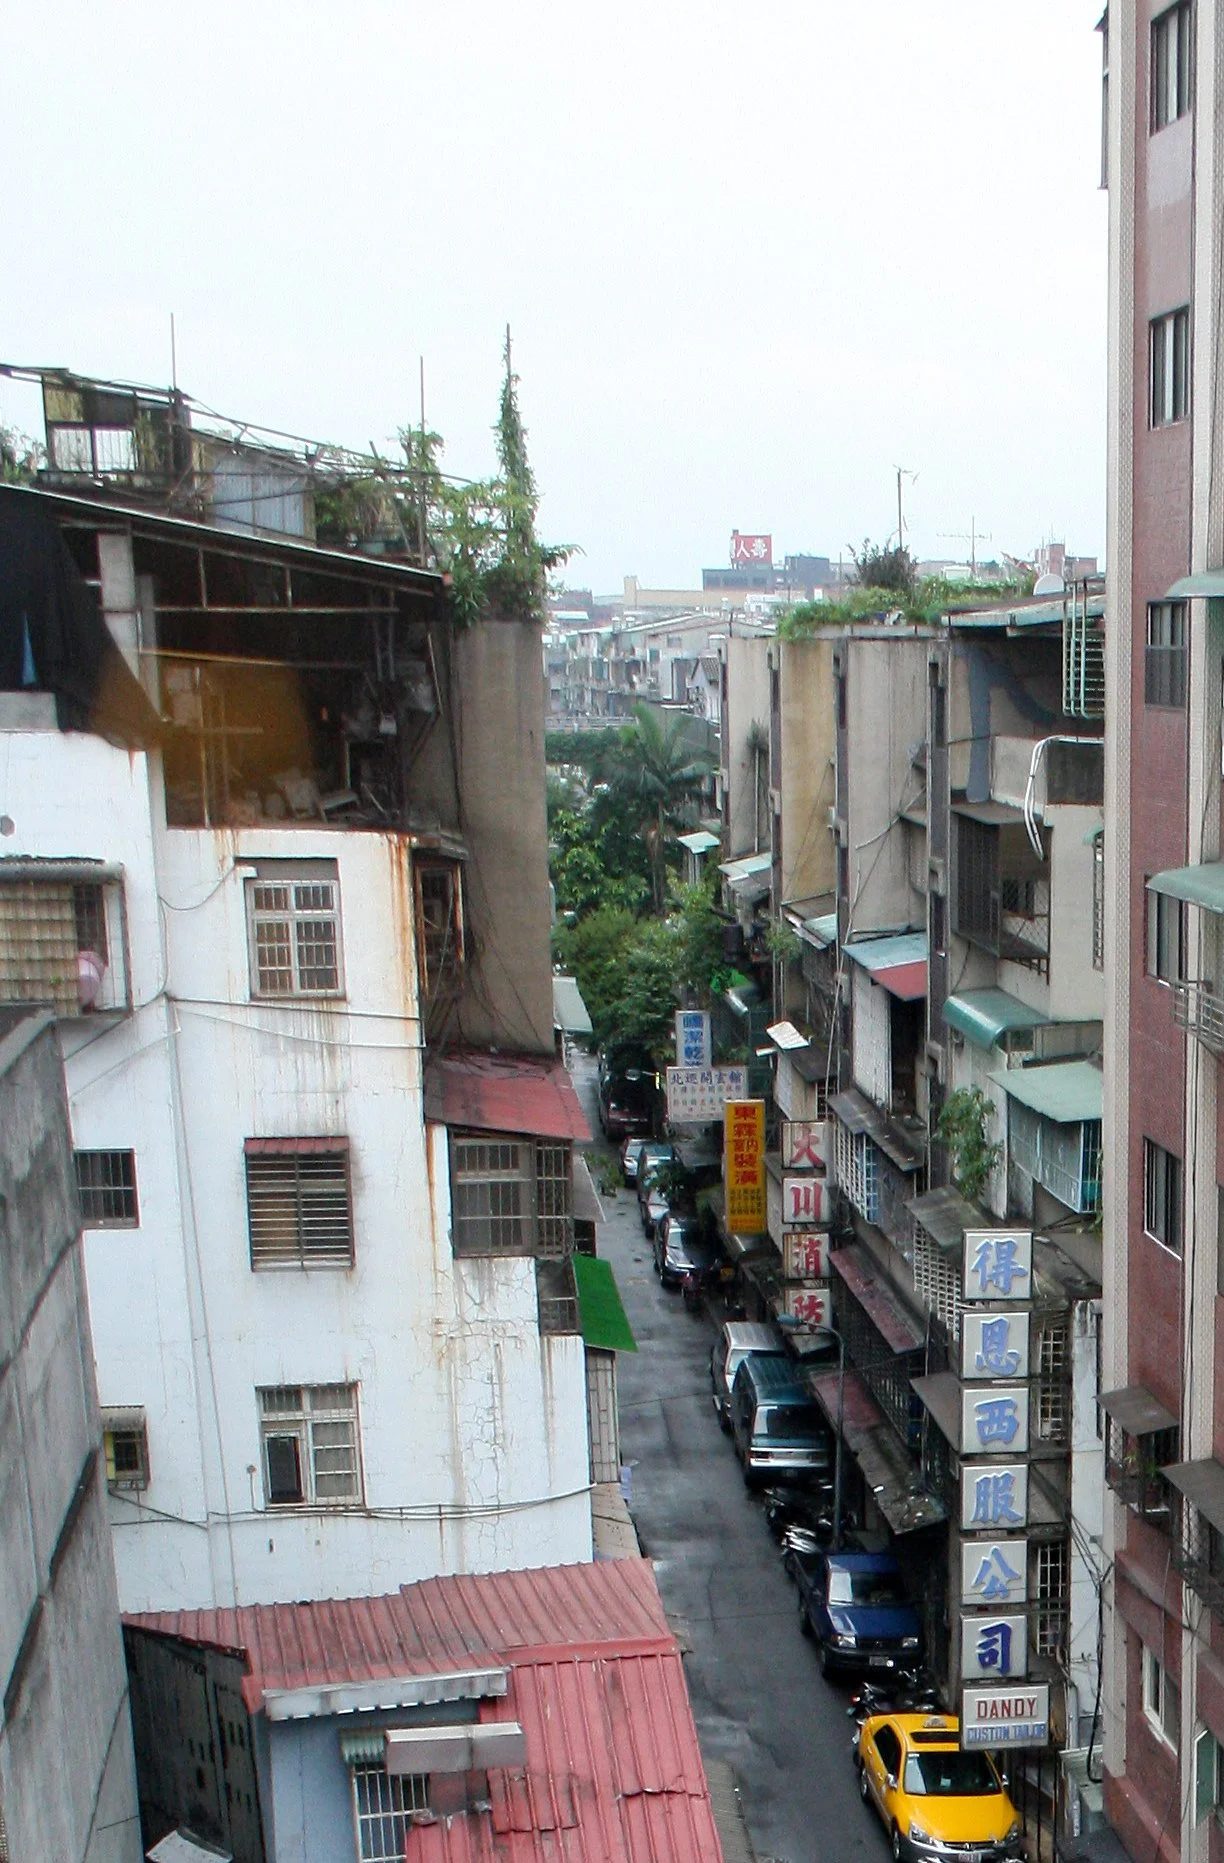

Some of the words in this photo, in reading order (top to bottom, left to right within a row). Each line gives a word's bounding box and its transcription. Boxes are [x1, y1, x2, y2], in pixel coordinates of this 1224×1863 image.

[790, 1122, 825, 1335] 大川消防
[971, 1238, 1028, 1676] 得恩西服公司
[977, 1698, 1036, 1718] DANDY
